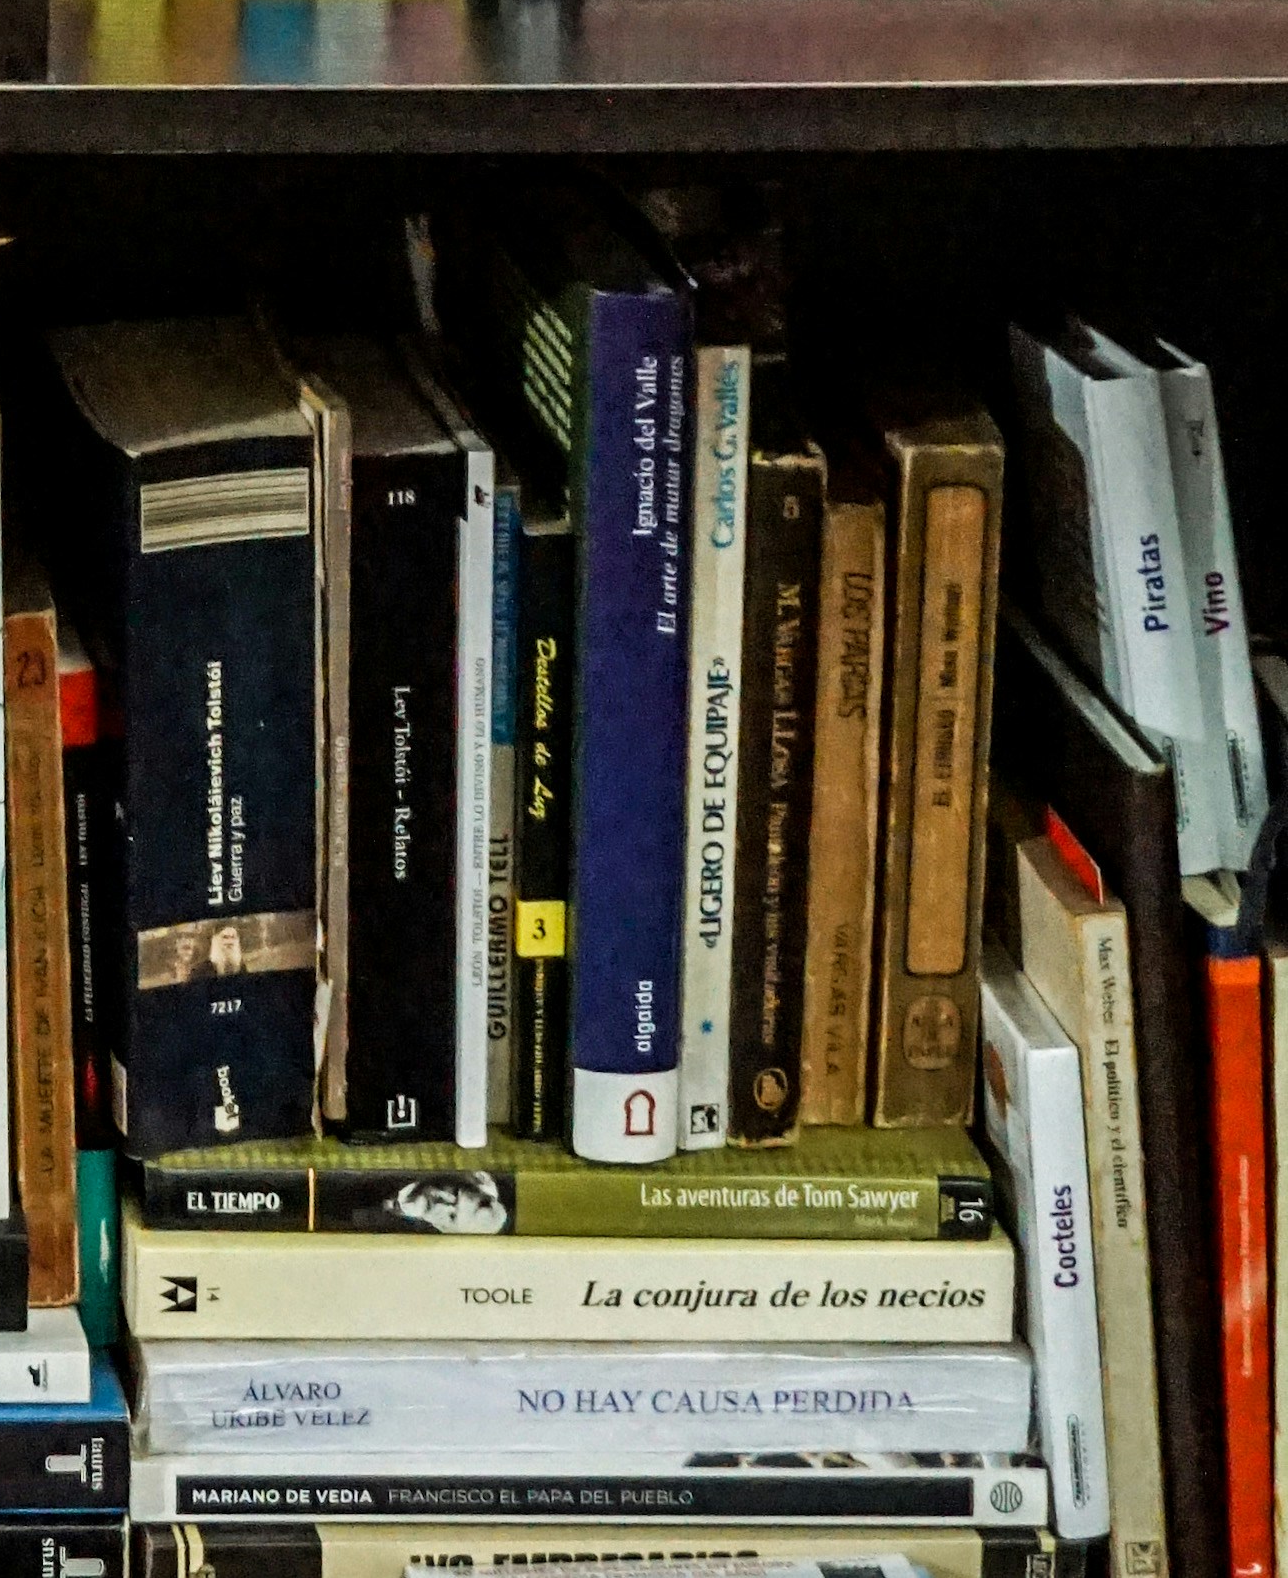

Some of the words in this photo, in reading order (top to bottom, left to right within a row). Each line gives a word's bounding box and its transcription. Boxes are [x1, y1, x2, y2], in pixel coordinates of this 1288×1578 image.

[635, 356, 658, 410] Valle
[633, 418, 656, 451] del
[631, 457, 658, 536] Ignacio
[1138, 533, 1170, 632] Piratas
[1201, 566, 1234, 640] Vino
[635, 979, 655, 1053] algaida
[1050, 1185, 1079, 1288] Cocteles
[460, 1287, 533, 1305] TOOLE
[581, 1280, 623, 1308] La
[632, 1280, 758, 1314] conjura
[769, 1280, 811, 1308] de
[819, 1280, 868, 1308] los
[877, 1280, 986, 1308] necios
[518, 1389, 566, 1413] NO
[575, 1389, 642, 1414] HAY
[651, 1389, 763, 1415] CAUSA
[774, 1389, 914, 1415] PERDIDA
